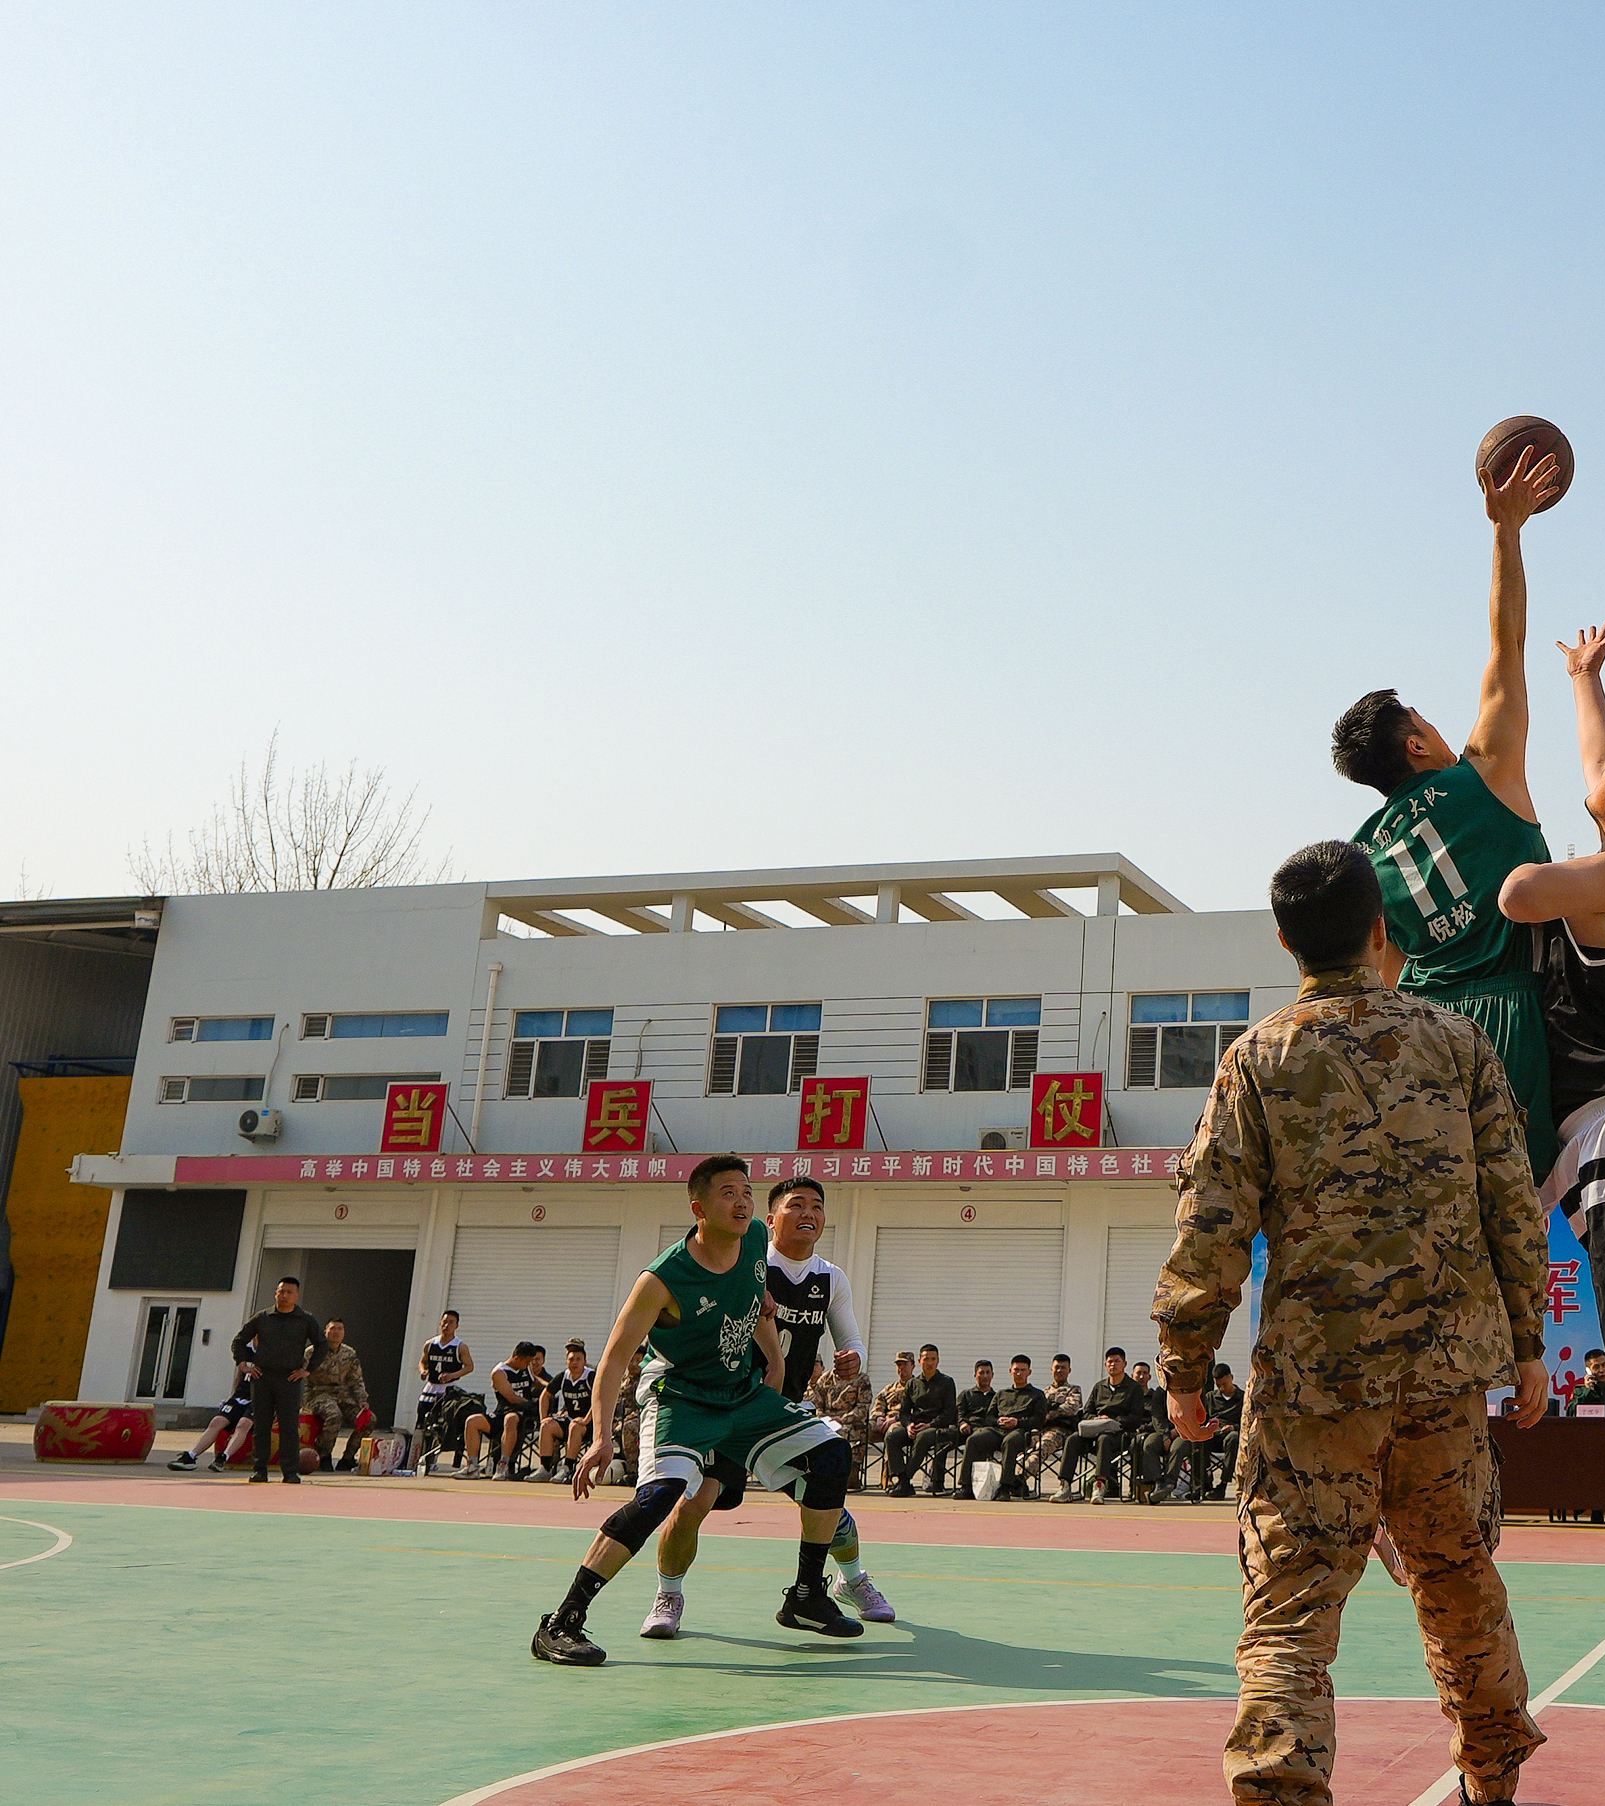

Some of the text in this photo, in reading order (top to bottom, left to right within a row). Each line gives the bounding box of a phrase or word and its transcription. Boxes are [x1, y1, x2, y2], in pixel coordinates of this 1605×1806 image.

[1385, 817, 1469, 918] 11
[1426, 900, 1477, 944] 倪松
[388, 1078, 1096, 1147] 当 兵 打 仗
